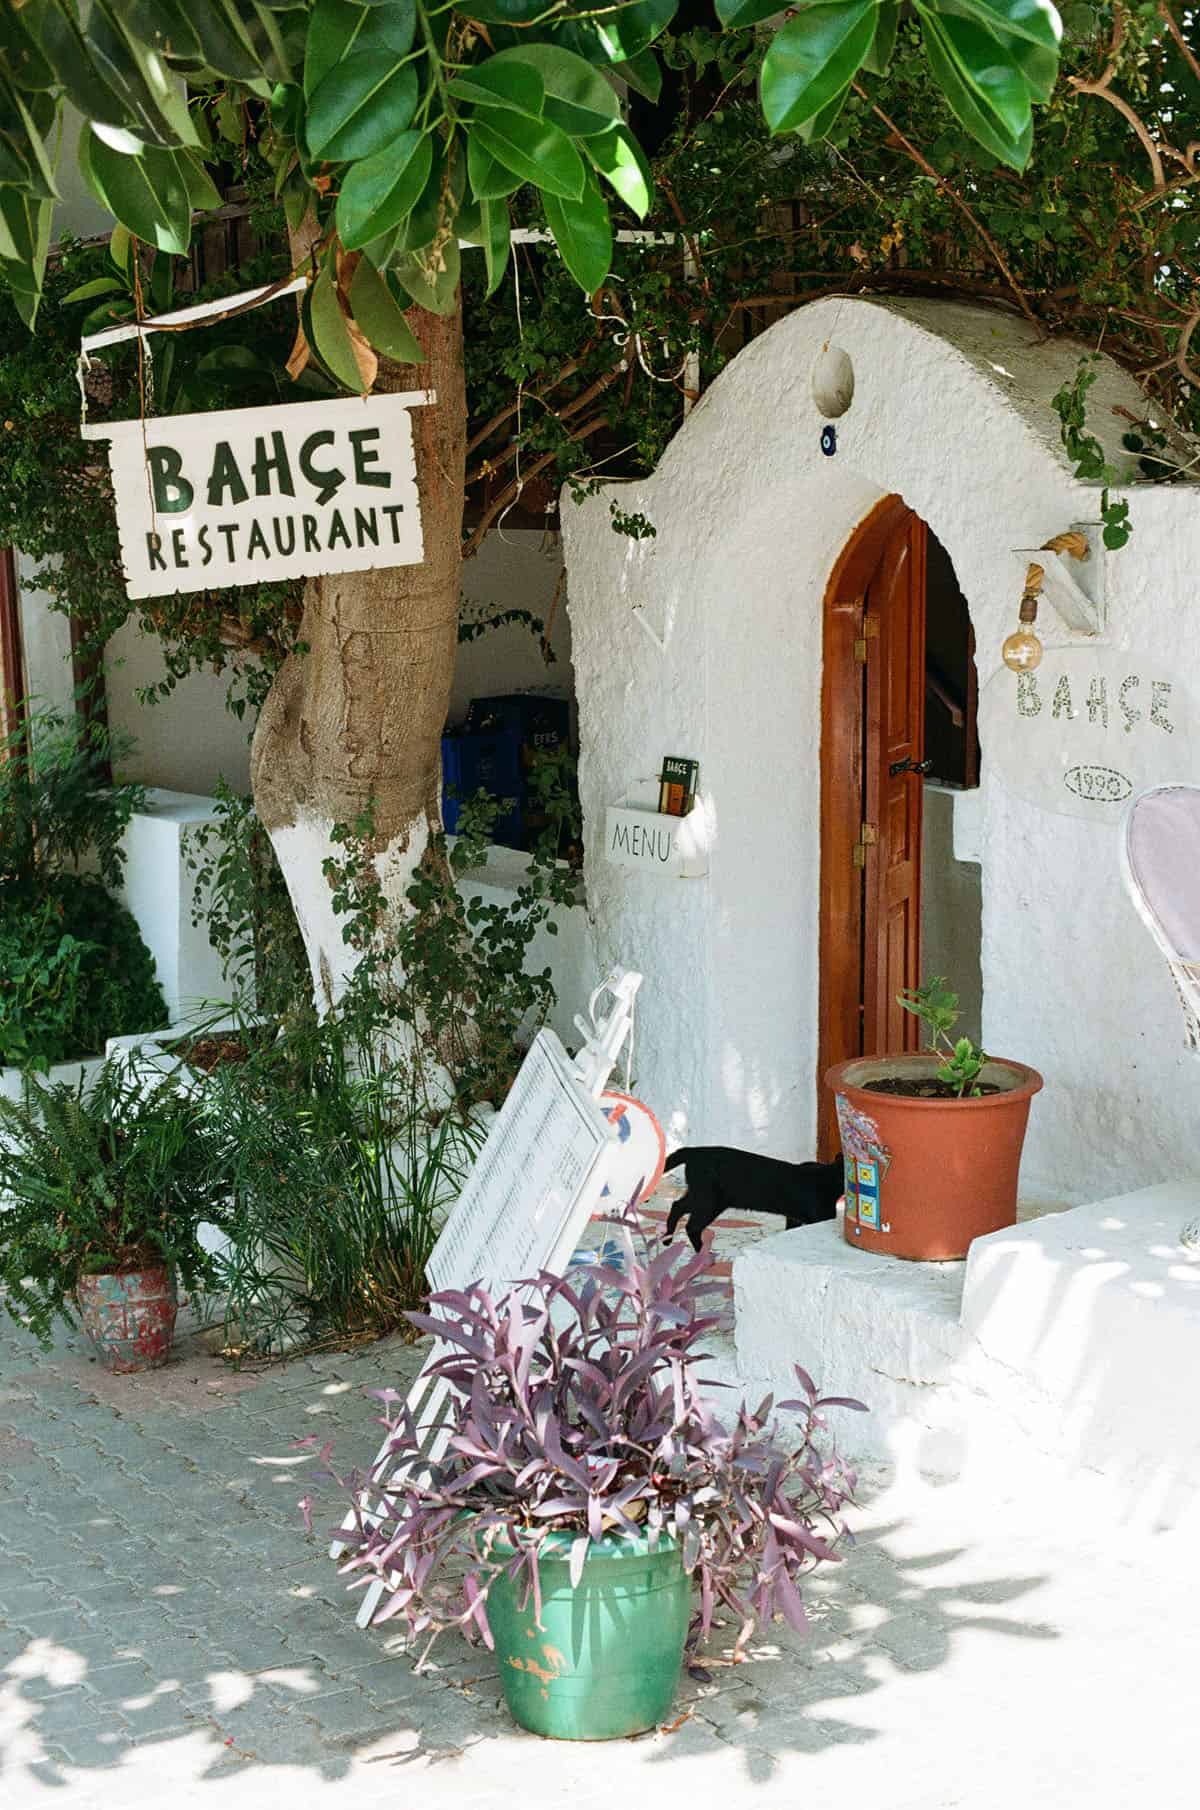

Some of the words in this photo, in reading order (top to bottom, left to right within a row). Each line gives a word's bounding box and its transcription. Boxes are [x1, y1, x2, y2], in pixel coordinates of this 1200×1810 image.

[146, 427, 391, 513] BAHÇE
[146, 505, 404, 570] RESTAURANT
[1017, 671, 1174, 733] BAHÇE
[1074, 772, 1121, 796] 1990
[612, 823, 671, 862] MENU
